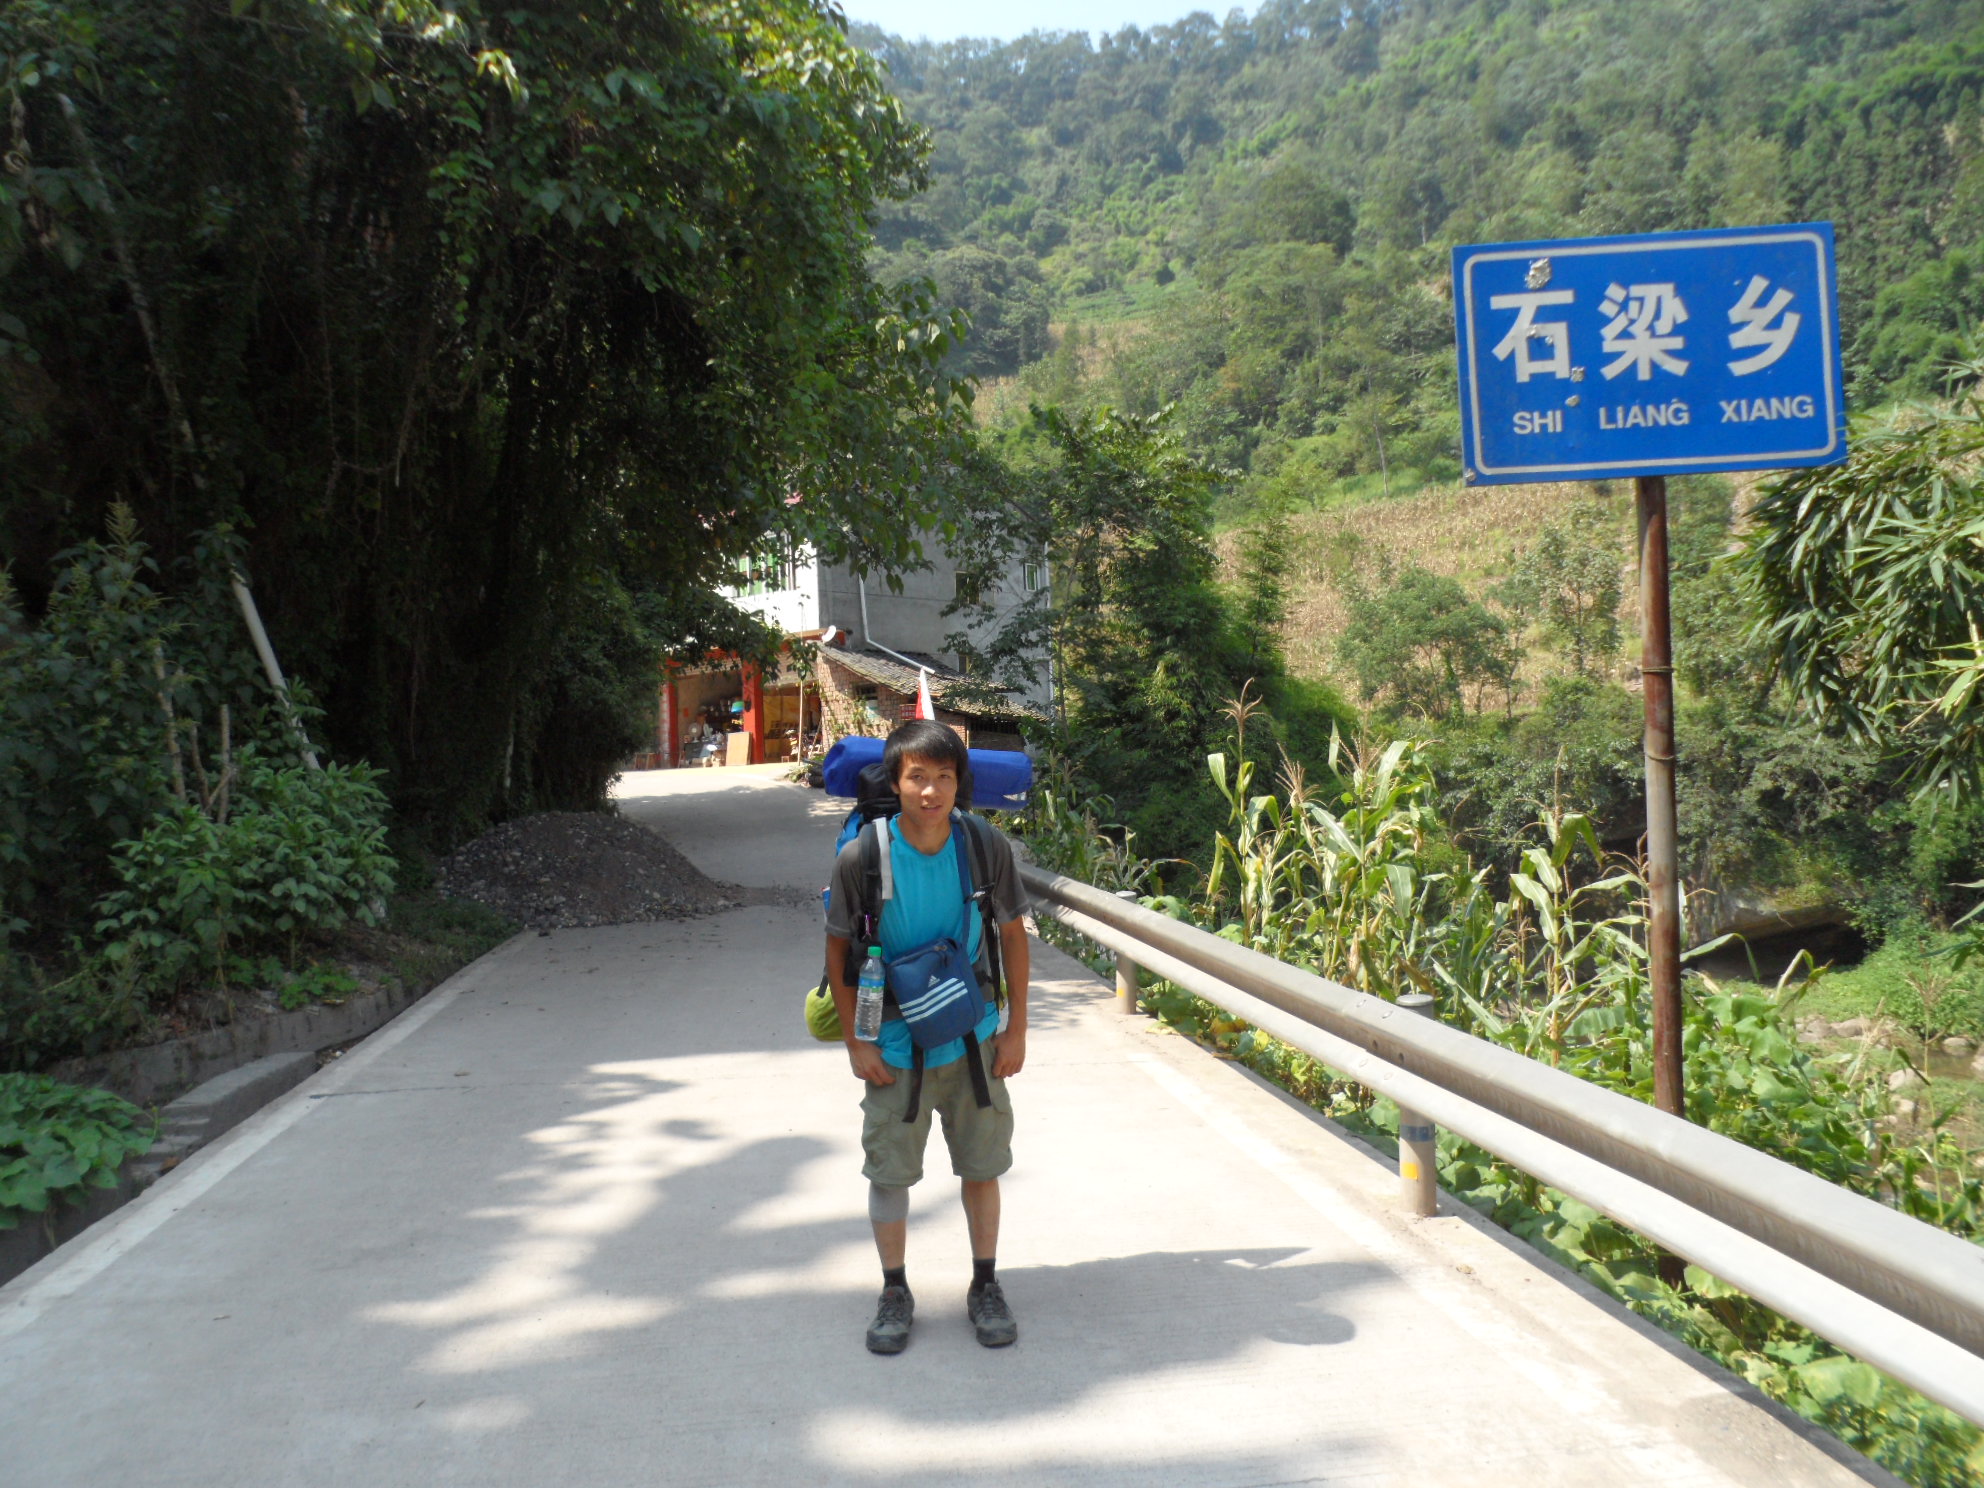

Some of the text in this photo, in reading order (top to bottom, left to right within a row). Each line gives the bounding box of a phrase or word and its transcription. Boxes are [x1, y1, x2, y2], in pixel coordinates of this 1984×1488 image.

[1490, 275, 1801, 383] 石梁乡
[1512, 395, 1815, 435] SHI LIANG XIANG
